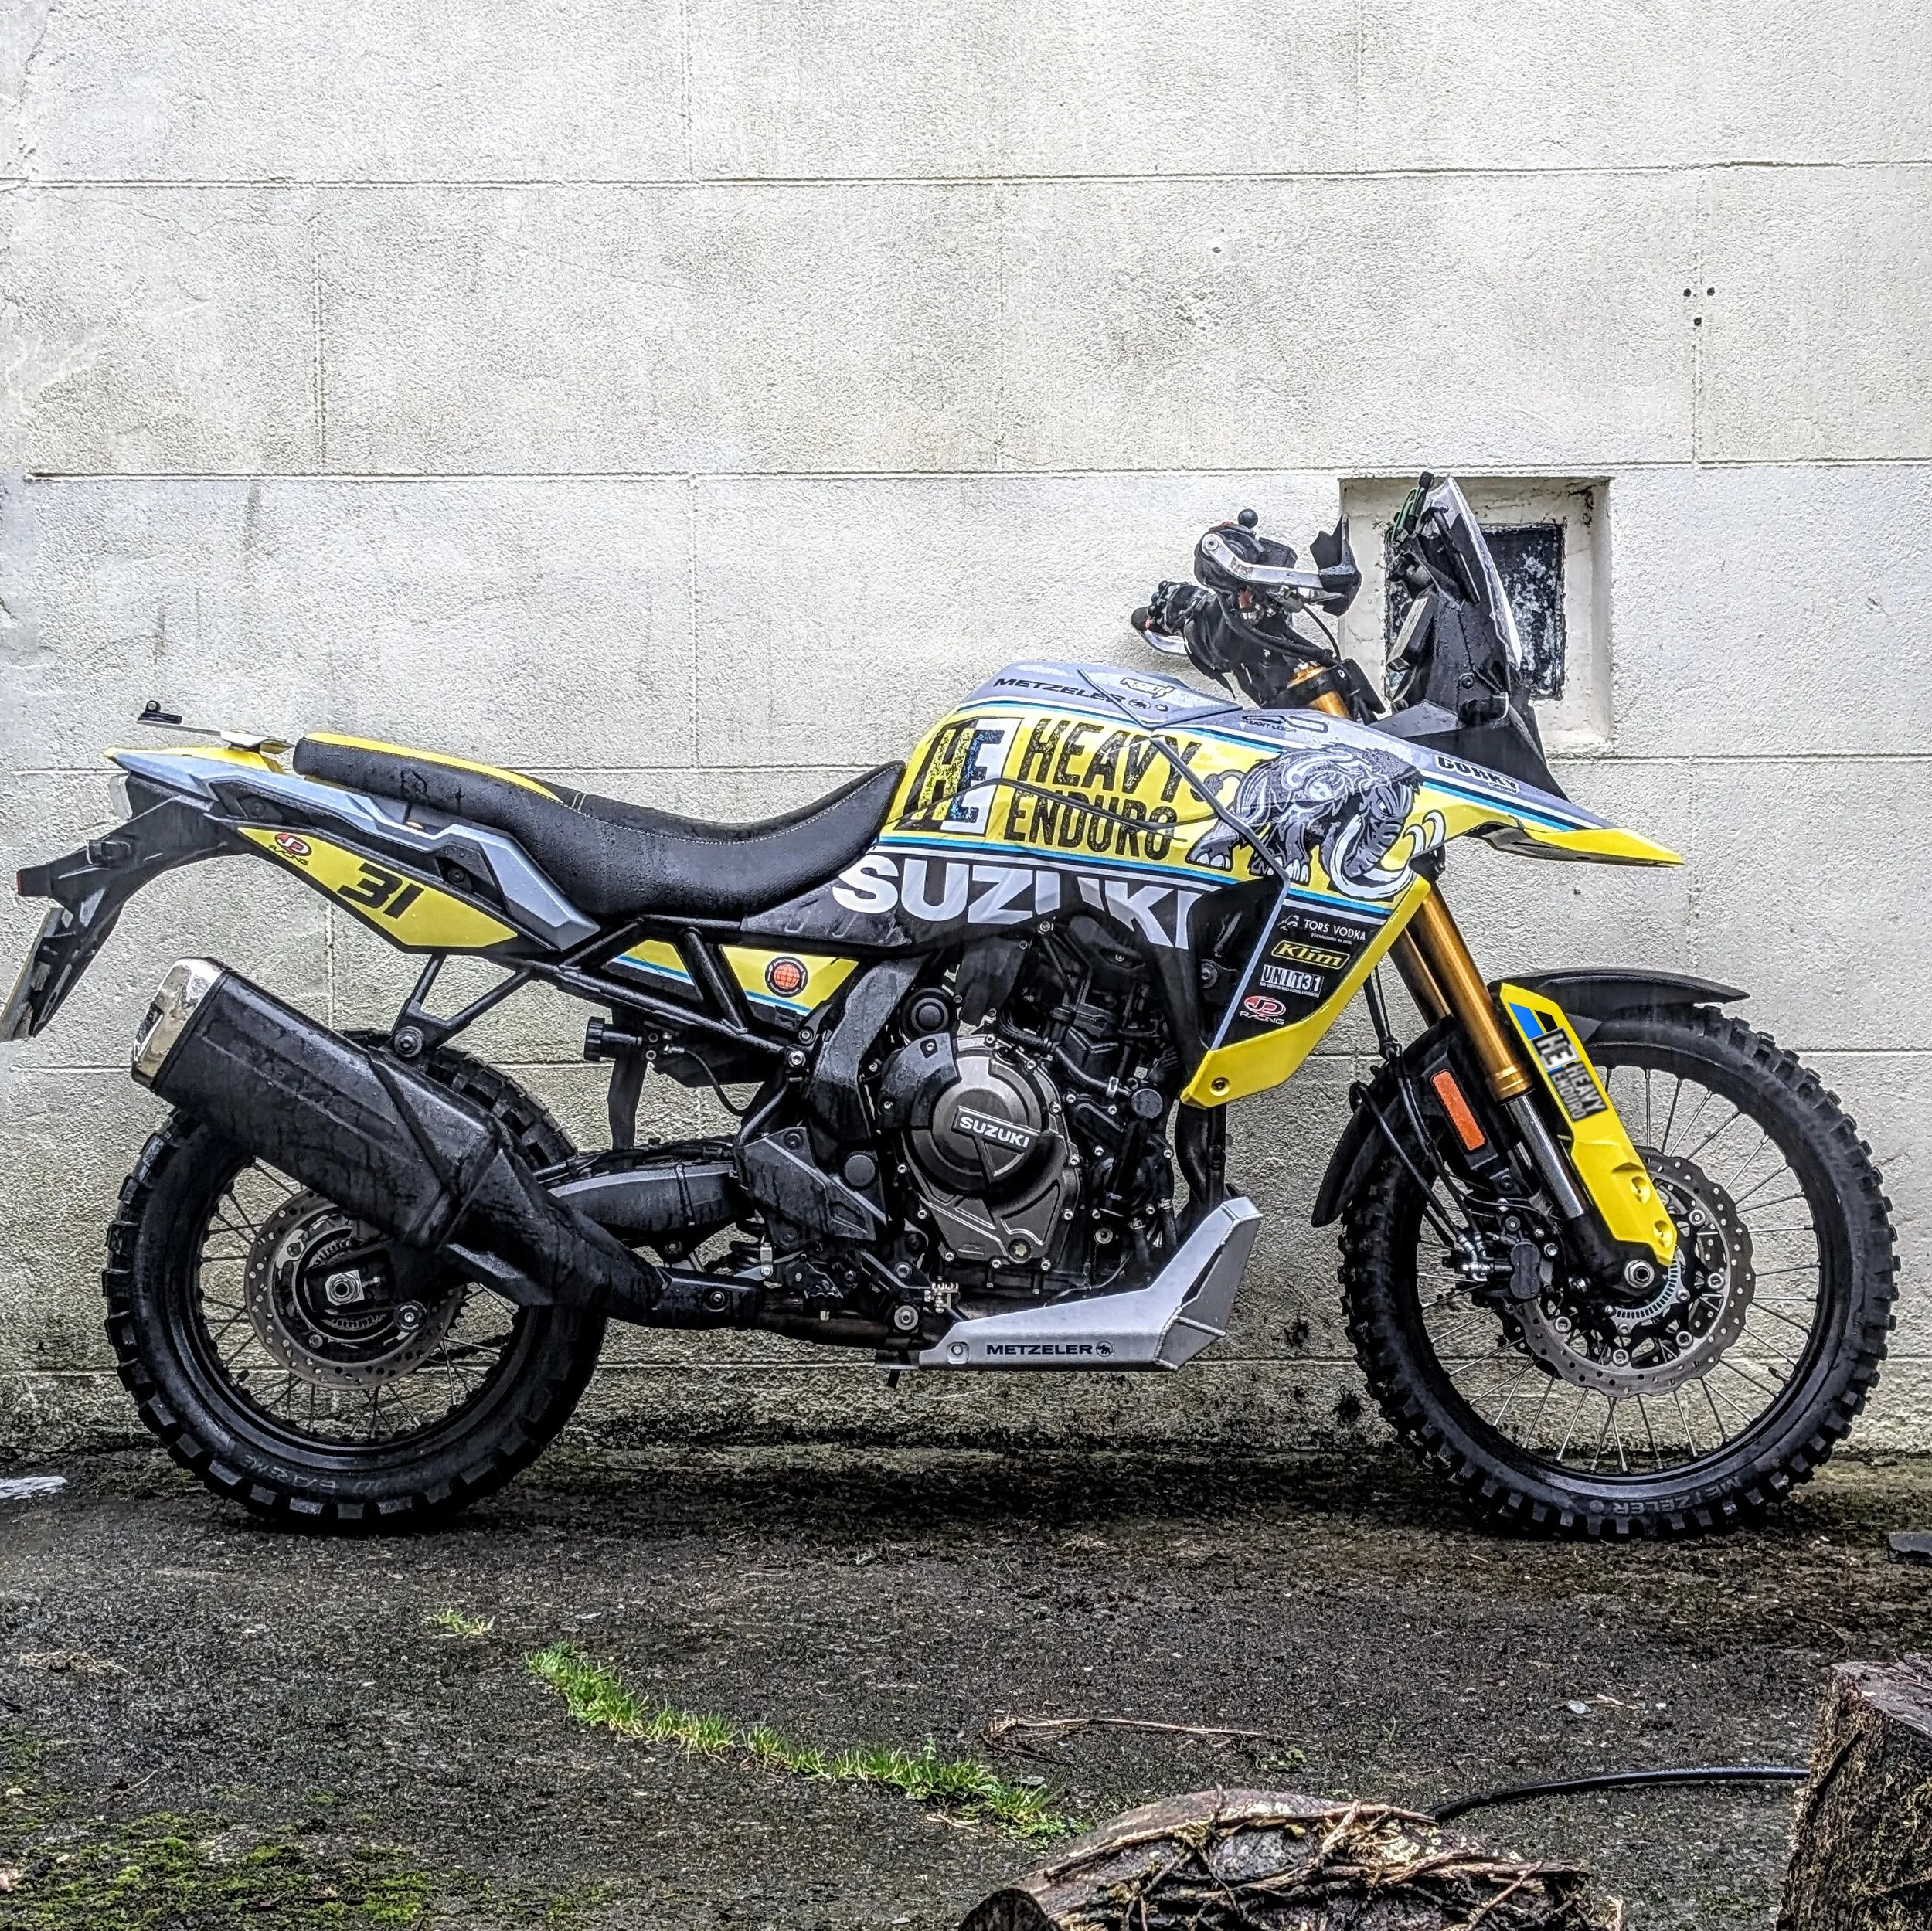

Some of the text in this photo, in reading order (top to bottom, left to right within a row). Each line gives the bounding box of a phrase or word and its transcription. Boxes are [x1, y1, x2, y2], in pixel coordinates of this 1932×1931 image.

[993, 678, 1126, 702] METZELER
[1018, 719, 1200, 803] HEAVY
[1003, 783, 1179, 860] ENDURO
[337, 862, 424, 919] 31
[1304, 919, 1329, 933] TORS
[1333, 926, 1366, 940] VODKA
[1550, 1071, 1587, 1120] ENDURO
[1565, 1062, 1605, 1111] HEAVY
[959, 1115, 1029, 1148] SUZUKI
[987, 1344, 1092, 1355] METZELER
